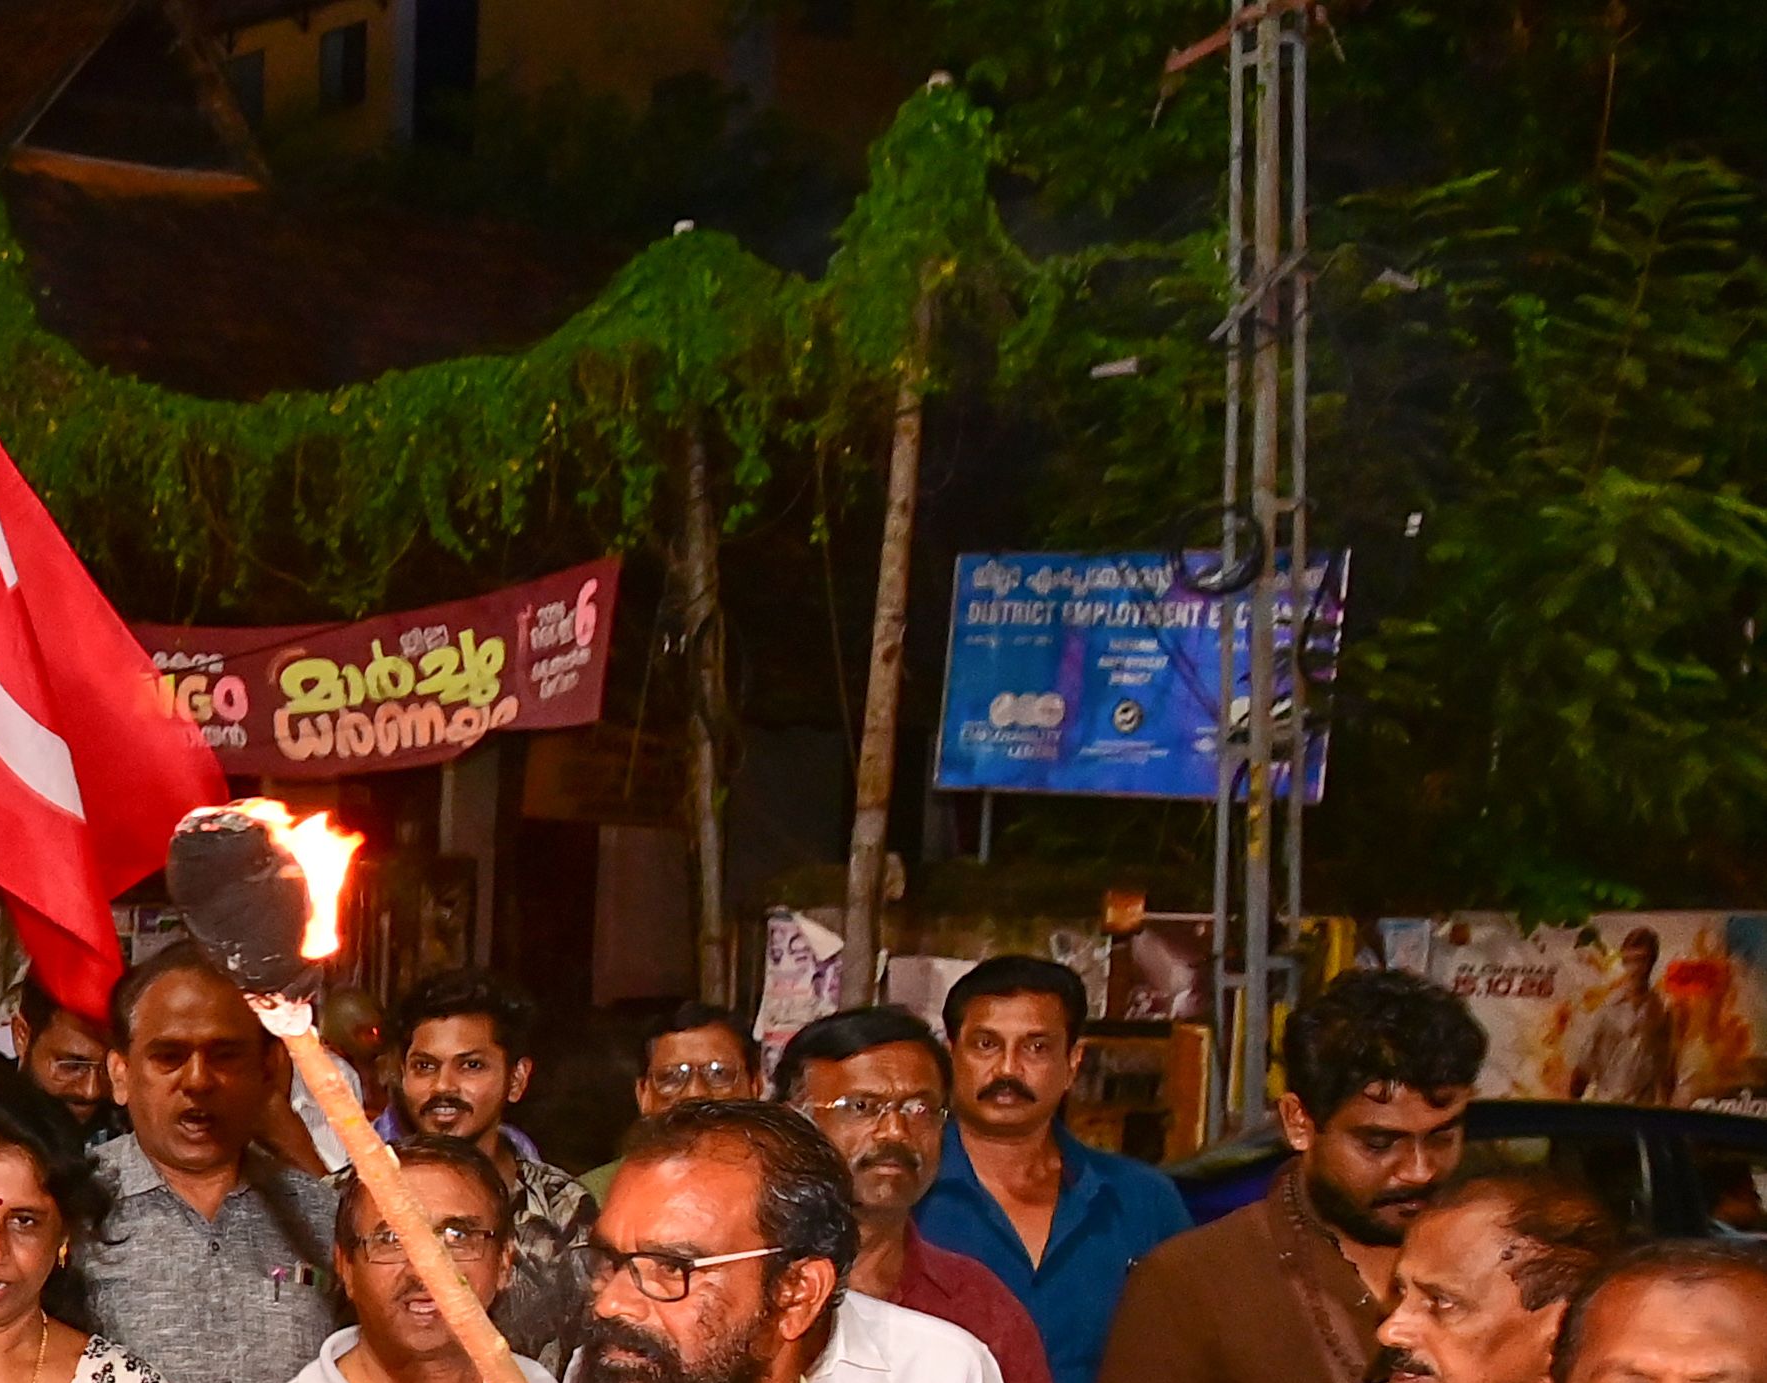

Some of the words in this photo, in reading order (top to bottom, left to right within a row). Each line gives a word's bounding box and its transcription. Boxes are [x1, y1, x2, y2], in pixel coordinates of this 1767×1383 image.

[575, 578, 597, 646] 6
[967, 601, 1055, 625] DISTRICT
[1062, 601, 1203, 628] EMPLOYMENT
[141, 672, 249, 724] NGO
